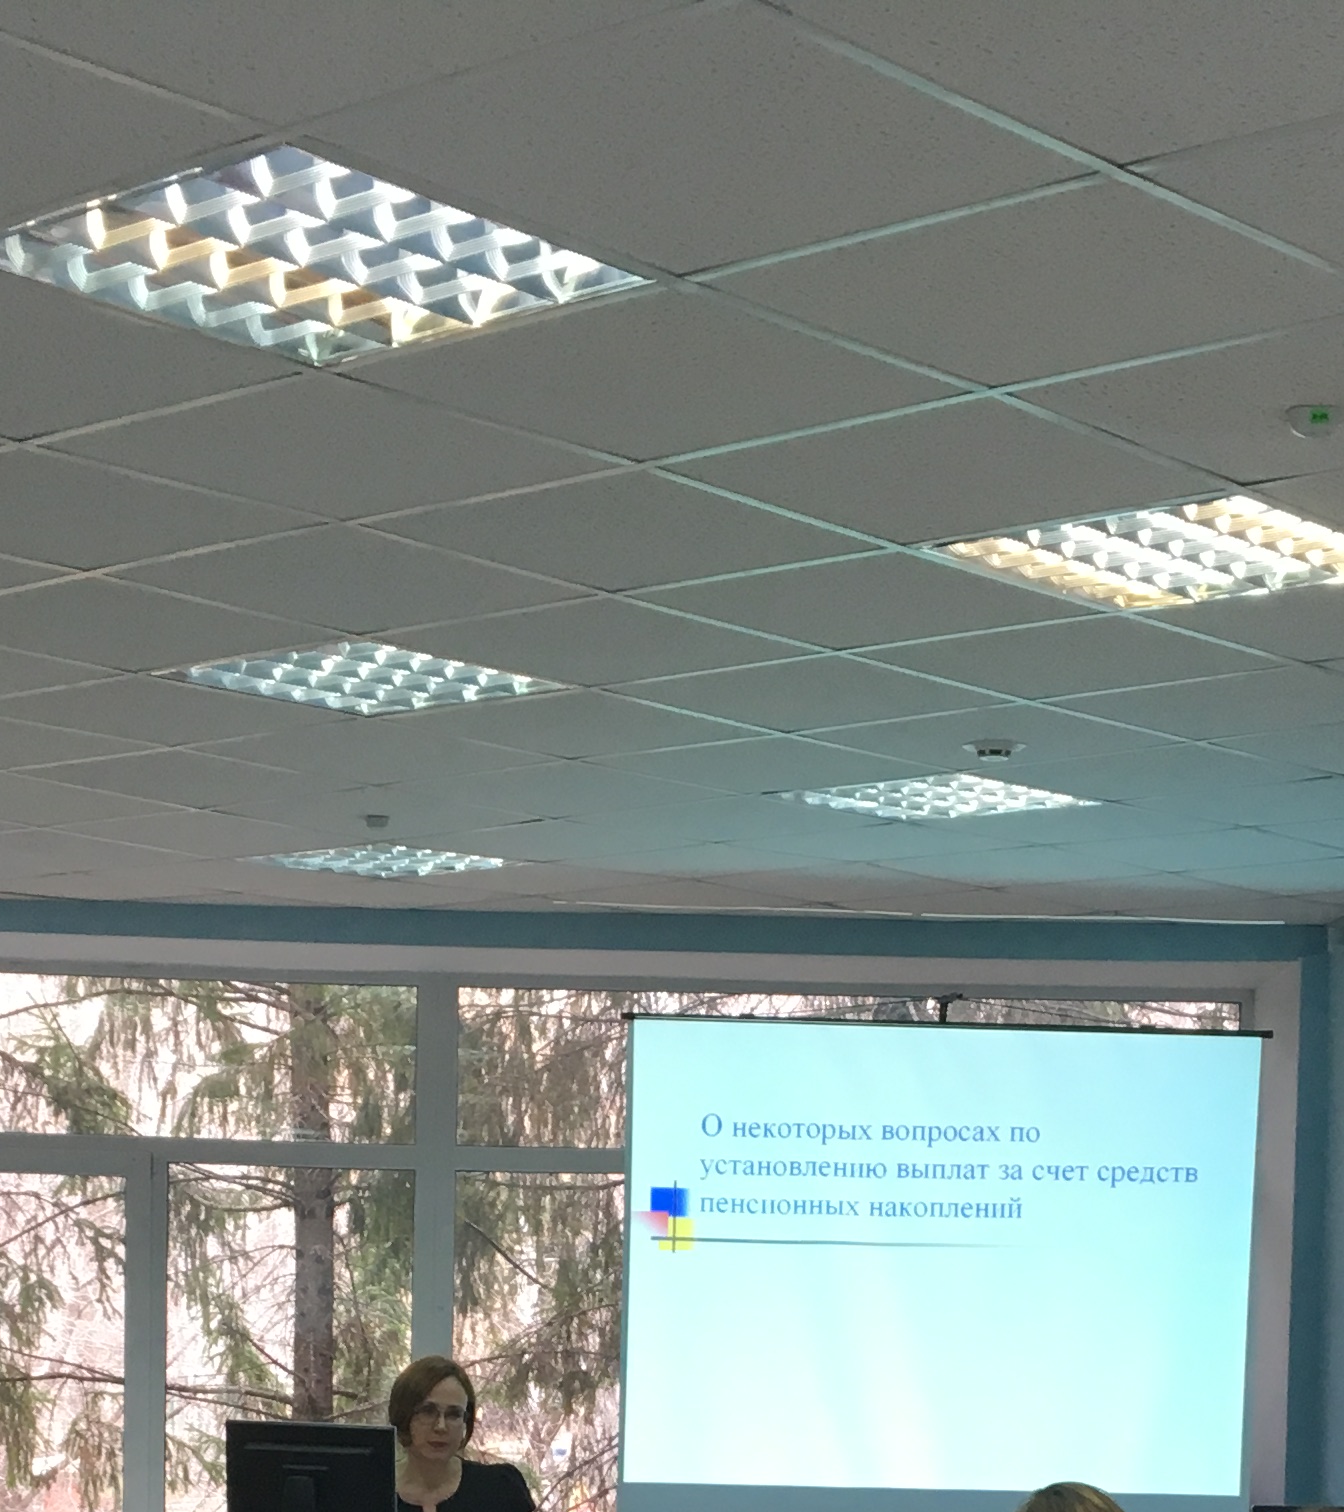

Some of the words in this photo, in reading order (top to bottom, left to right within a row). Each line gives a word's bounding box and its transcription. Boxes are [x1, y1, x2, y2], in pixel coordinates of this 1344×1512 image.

[701, 1112, 723, 1138] О
[732, 1121, 873, 1146] некоторых
[881, 1124, 1001, 1148] вопросах
[1009, 1126, 1041, 1143] по
[699, 1158, 887, 1181] установлению
[896, 1162, 990, 1180] выплат
[998, 1163, 1023, 1181] за
[1031, 1164, 1089, 1182] счет
[1096, 1164, 1199, 1189] средств
[699, 1196, 860, 1217] пенсионных
[869, 1196, 1023, 1219] накоплений
